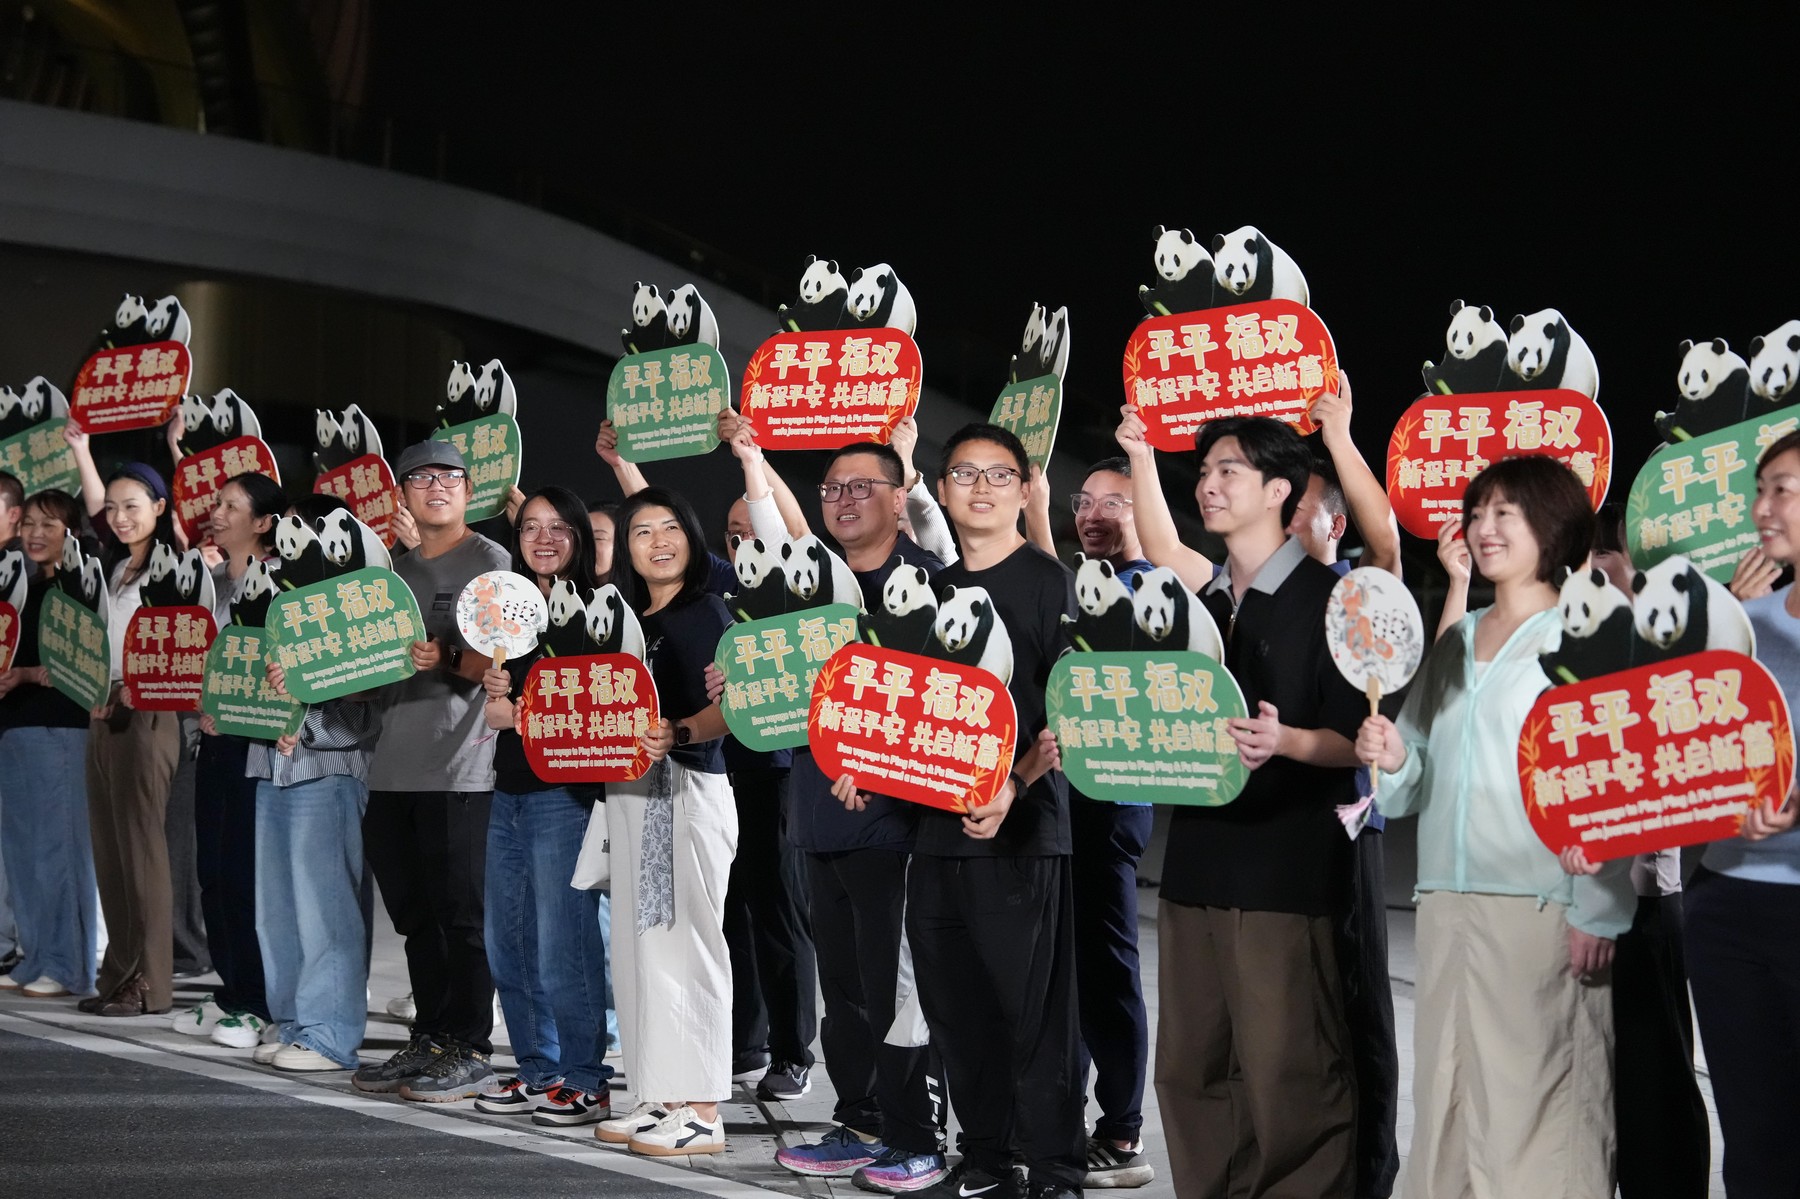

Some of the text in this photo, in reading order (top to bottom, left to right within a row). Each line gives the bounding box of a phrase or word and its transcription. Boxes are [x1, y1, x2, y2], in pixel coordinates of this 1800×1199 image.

[769, 336, 901, 381] 平平 福双
[1147, 312, 1302, 371] 平平 福双
[623, 353, 712, 398] 平平 福双
[749, 377, 909, 408] 新程平安 共启新篇
[1134, 354, 1322, 406] 新程平安 共启新篇
[1418, 400, 1580, 455] 平平 福双
[1659, 441, 1745, 504] 平平
[1438, 499, 1462, 509] voyag
[280, 578, 394, 637] 平平 福双
[733, 628, 794, 675] 平平
[538, 662, 637, 710] 平平 福双
[725, 671, 798, 710] 新程平安
[843, 655, 914, 711] 平平
[921, 667, 994, 728] 福双
[1070, 660, 1217, 716] 平平 福双
[527, 706, 648, 739] 新程平安 共启新篇
[818, 698, 1002, 770] 新程平安 共启新篇
[1057, 715, 1237, 754] 新程平安 共启新篇
[1548, 669, 1747, 757] 平平 福双
[1532, 721, 1774, 806] 新程平安 共启新篇
[909, 1157, 936, 1173] HOKA
